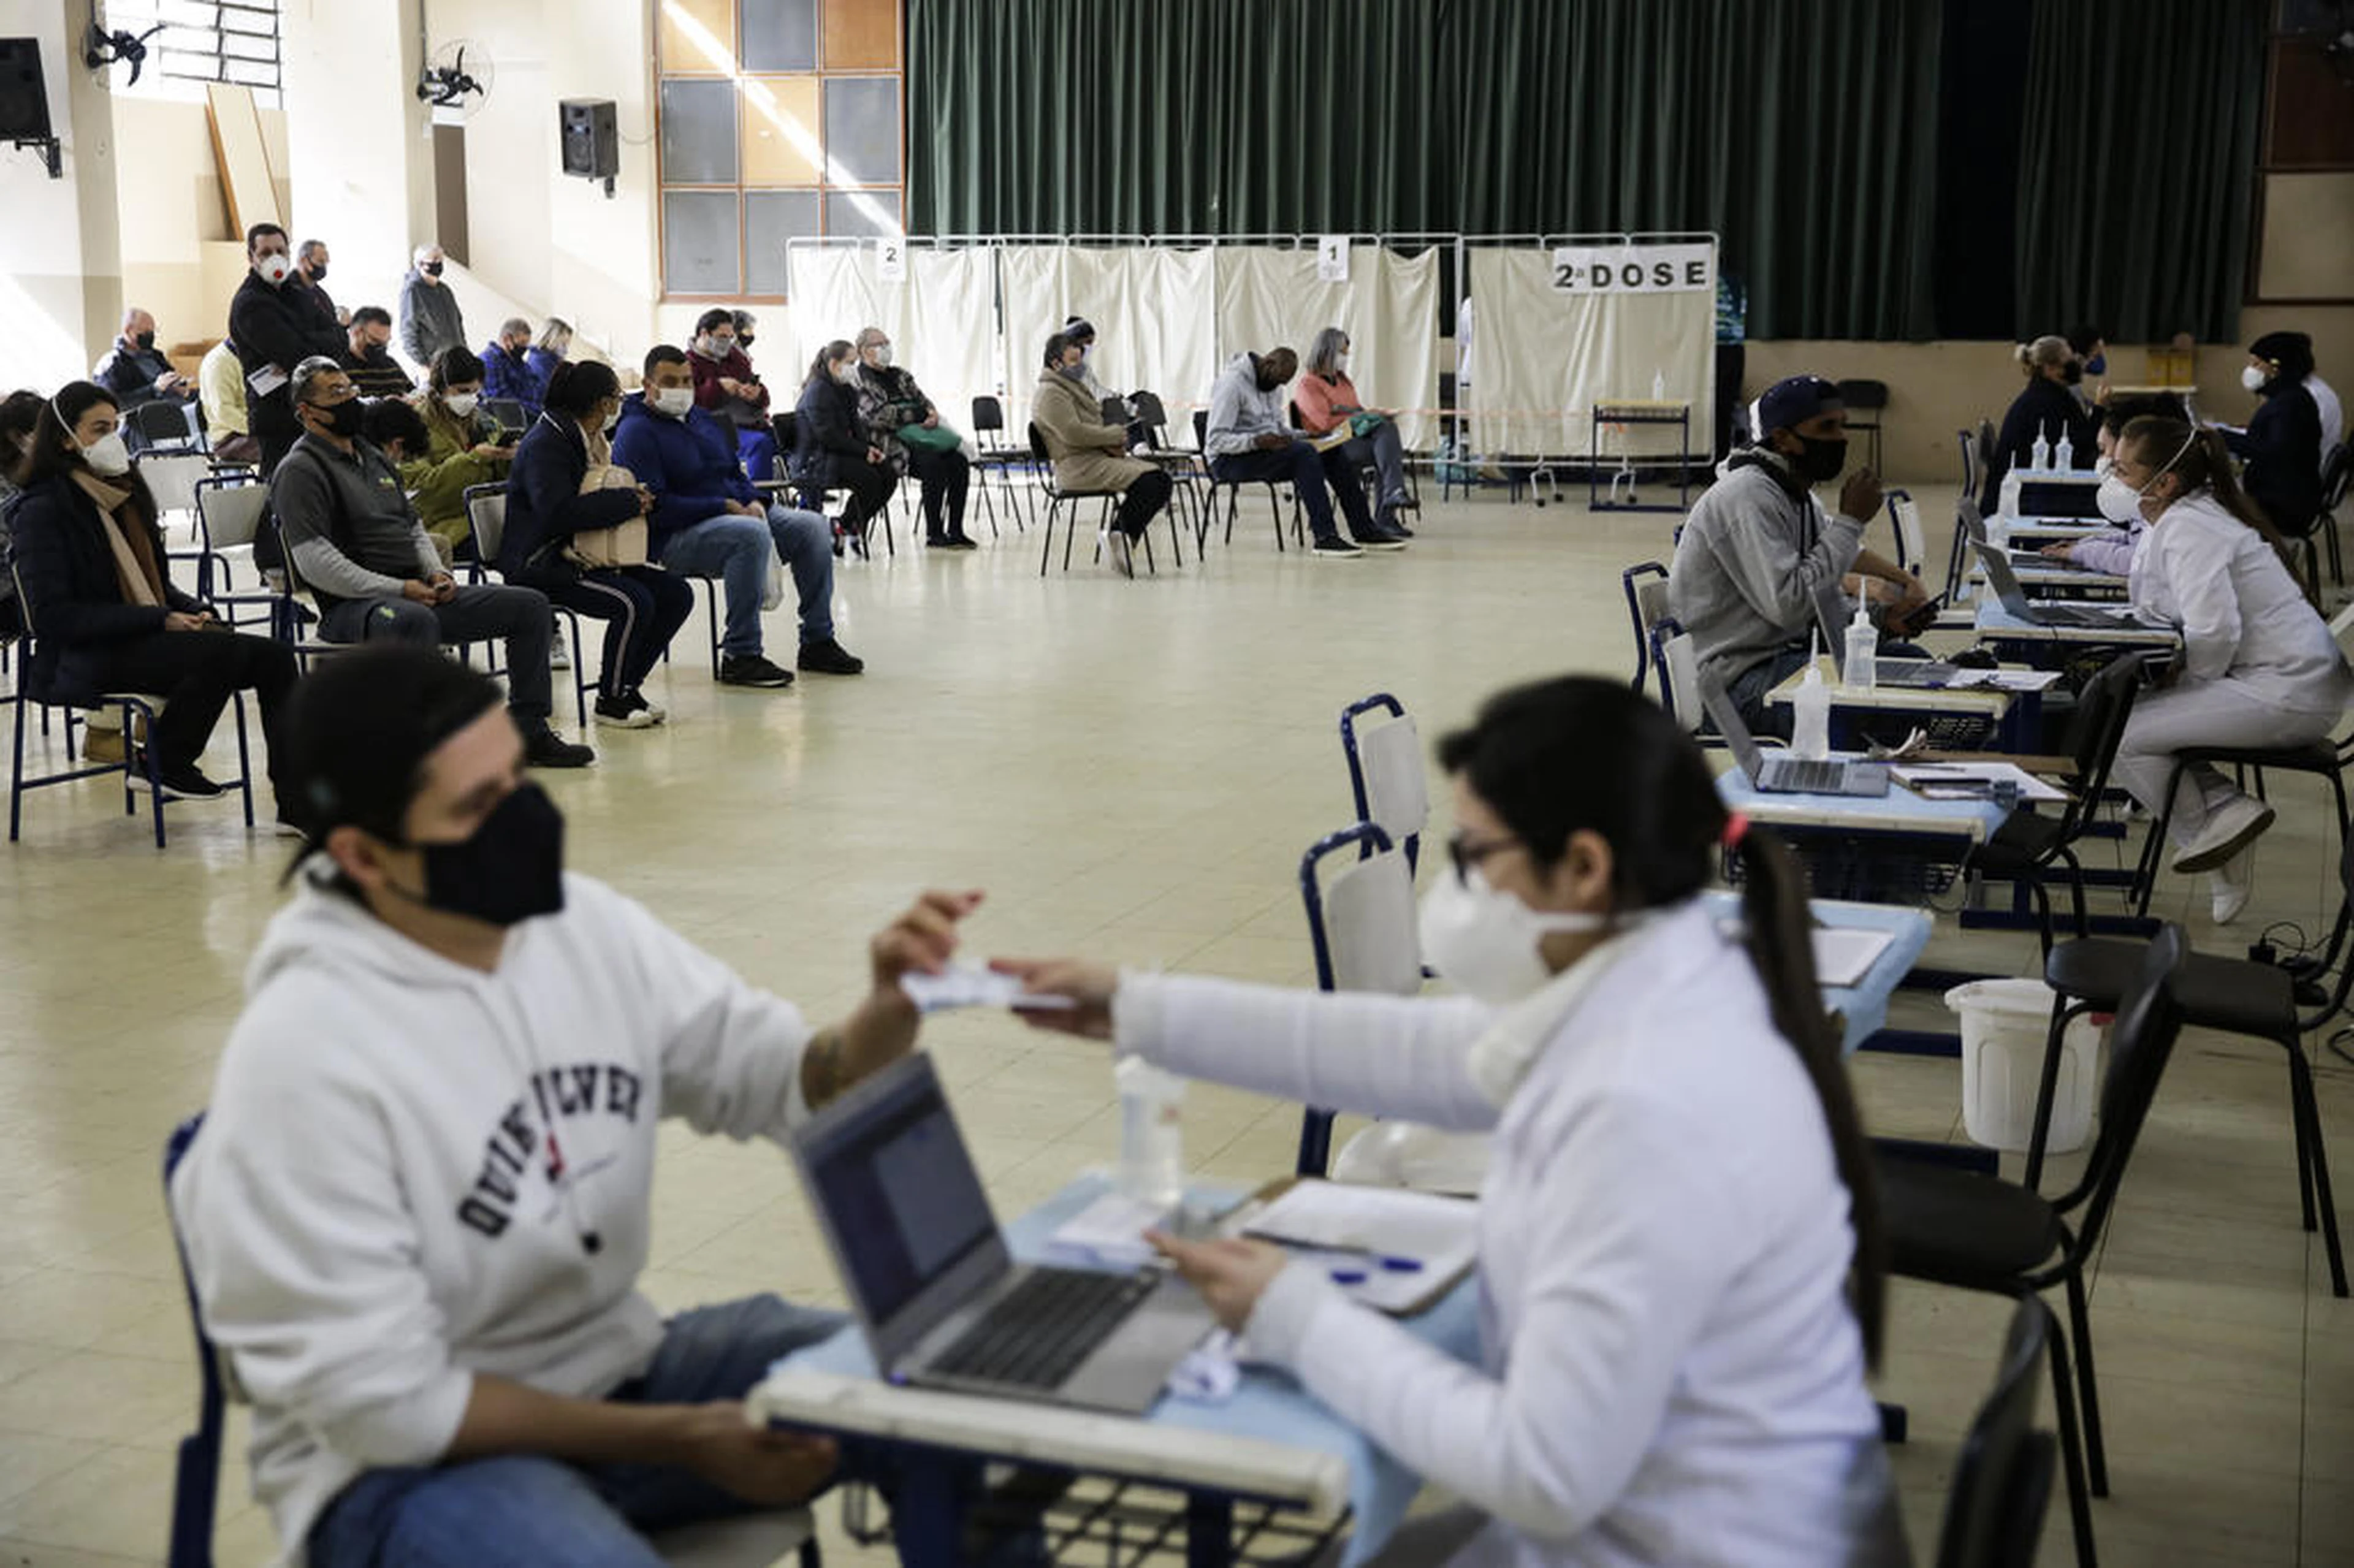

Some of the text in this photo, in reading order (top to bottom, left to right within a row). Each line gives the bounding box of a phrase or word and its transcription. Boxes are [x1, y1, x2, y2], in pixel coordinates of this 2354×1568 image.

[886, 246, 897, 262] 2
[1328, 245, 1338, 261] 1
[1591, 260, 1706, 288] DOSE
